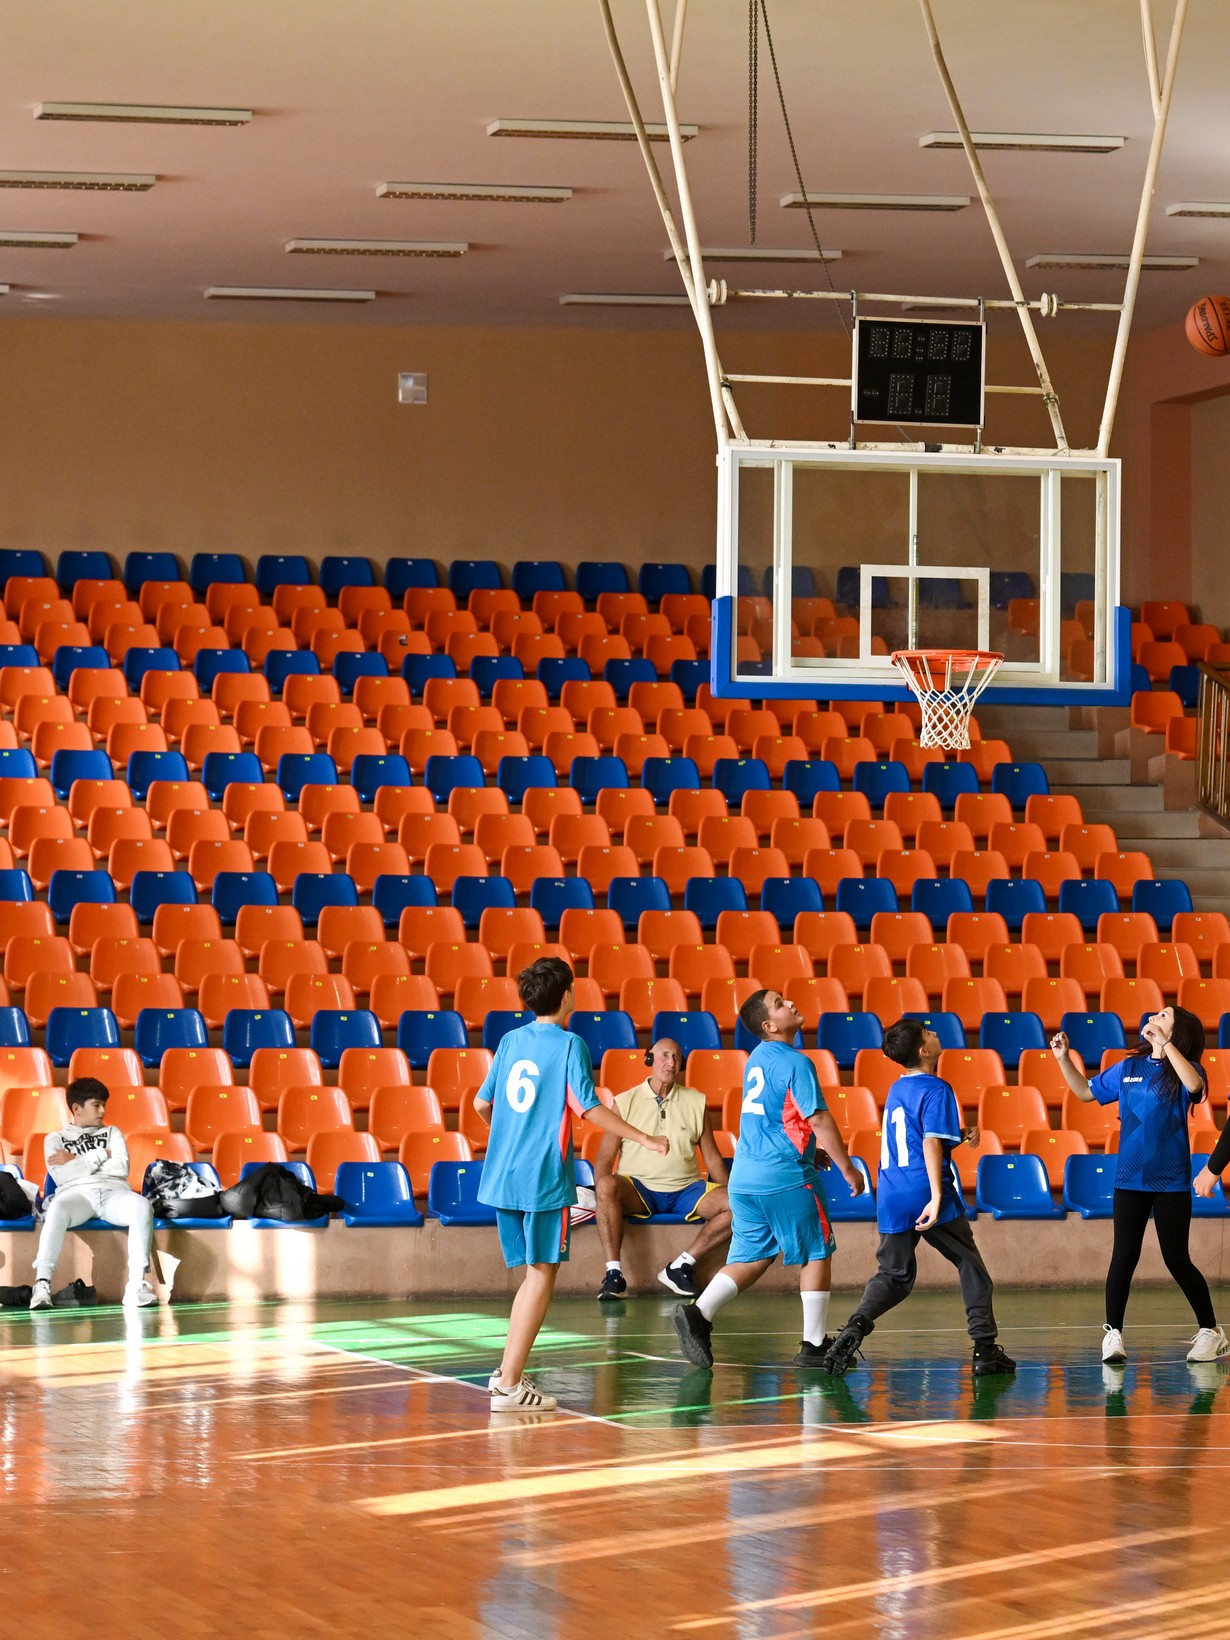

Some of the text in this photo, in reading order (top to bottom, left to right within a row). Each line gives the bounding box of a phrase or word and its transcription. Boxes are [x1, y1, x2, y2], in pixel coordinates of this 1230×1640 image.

[1197, 302, 1218, 342] SPALDING
[506, 1059, 540, 1114] 6
[741, 1066, 765, 1116] 2
